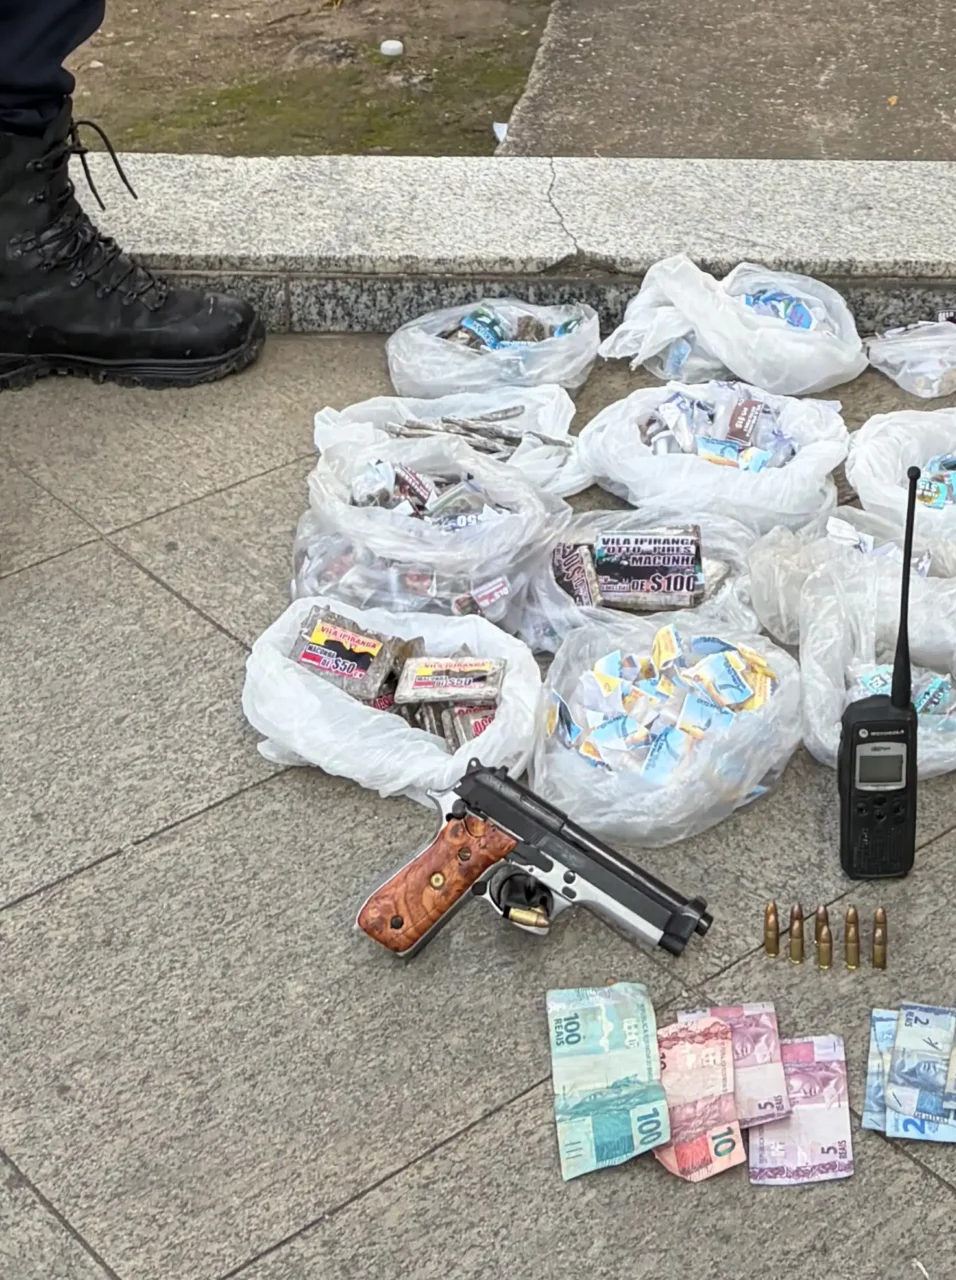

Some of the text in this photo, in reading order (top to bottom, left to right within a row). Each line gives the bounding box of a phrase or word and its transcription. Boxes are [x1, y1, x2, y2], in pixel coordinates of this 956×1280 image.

[554, 1018, 564, 1046] REAIS
[564, 1012, 581, 1045] 100
[914, 1015, 929, 1026] 2
[758, 1101, 775, 1111] 5
[636, 1106, 662, 1145] 100
[902, 1117, 926, 1135] 2
[711, 1126, 736, 1157] 10
[820, 1145, 838, 1155] 5
